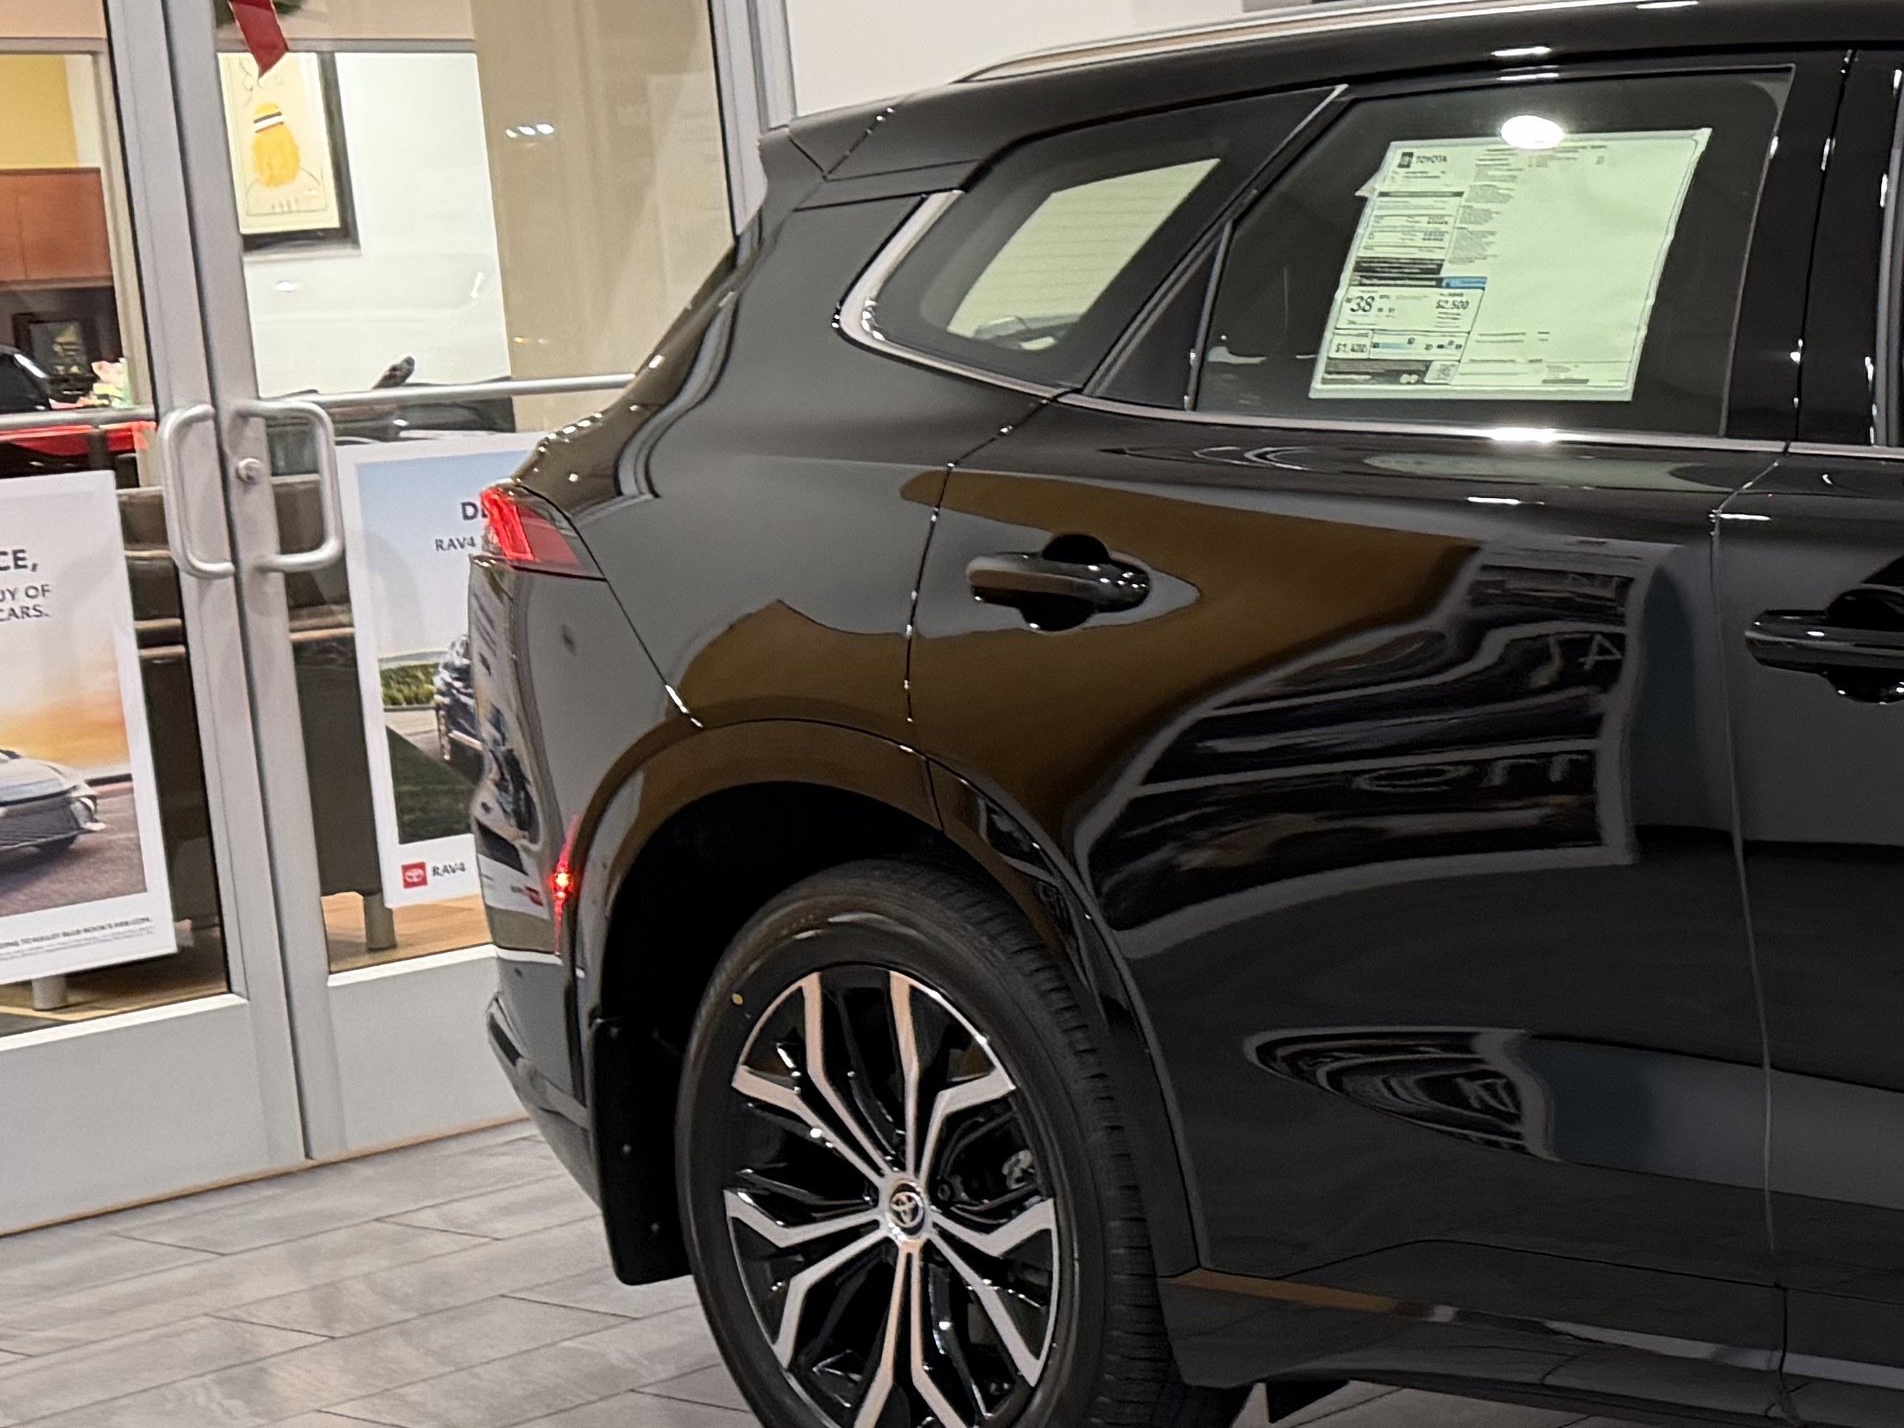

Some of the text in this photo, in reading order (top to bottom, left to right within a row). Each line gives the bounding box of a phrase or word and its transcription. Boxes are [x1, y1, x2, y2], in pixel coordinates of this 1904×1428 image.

[1350, 295, 1375, 313] 38
[435, 536, 476, 551] RAV4
[24, 584, 51, 599] OF
